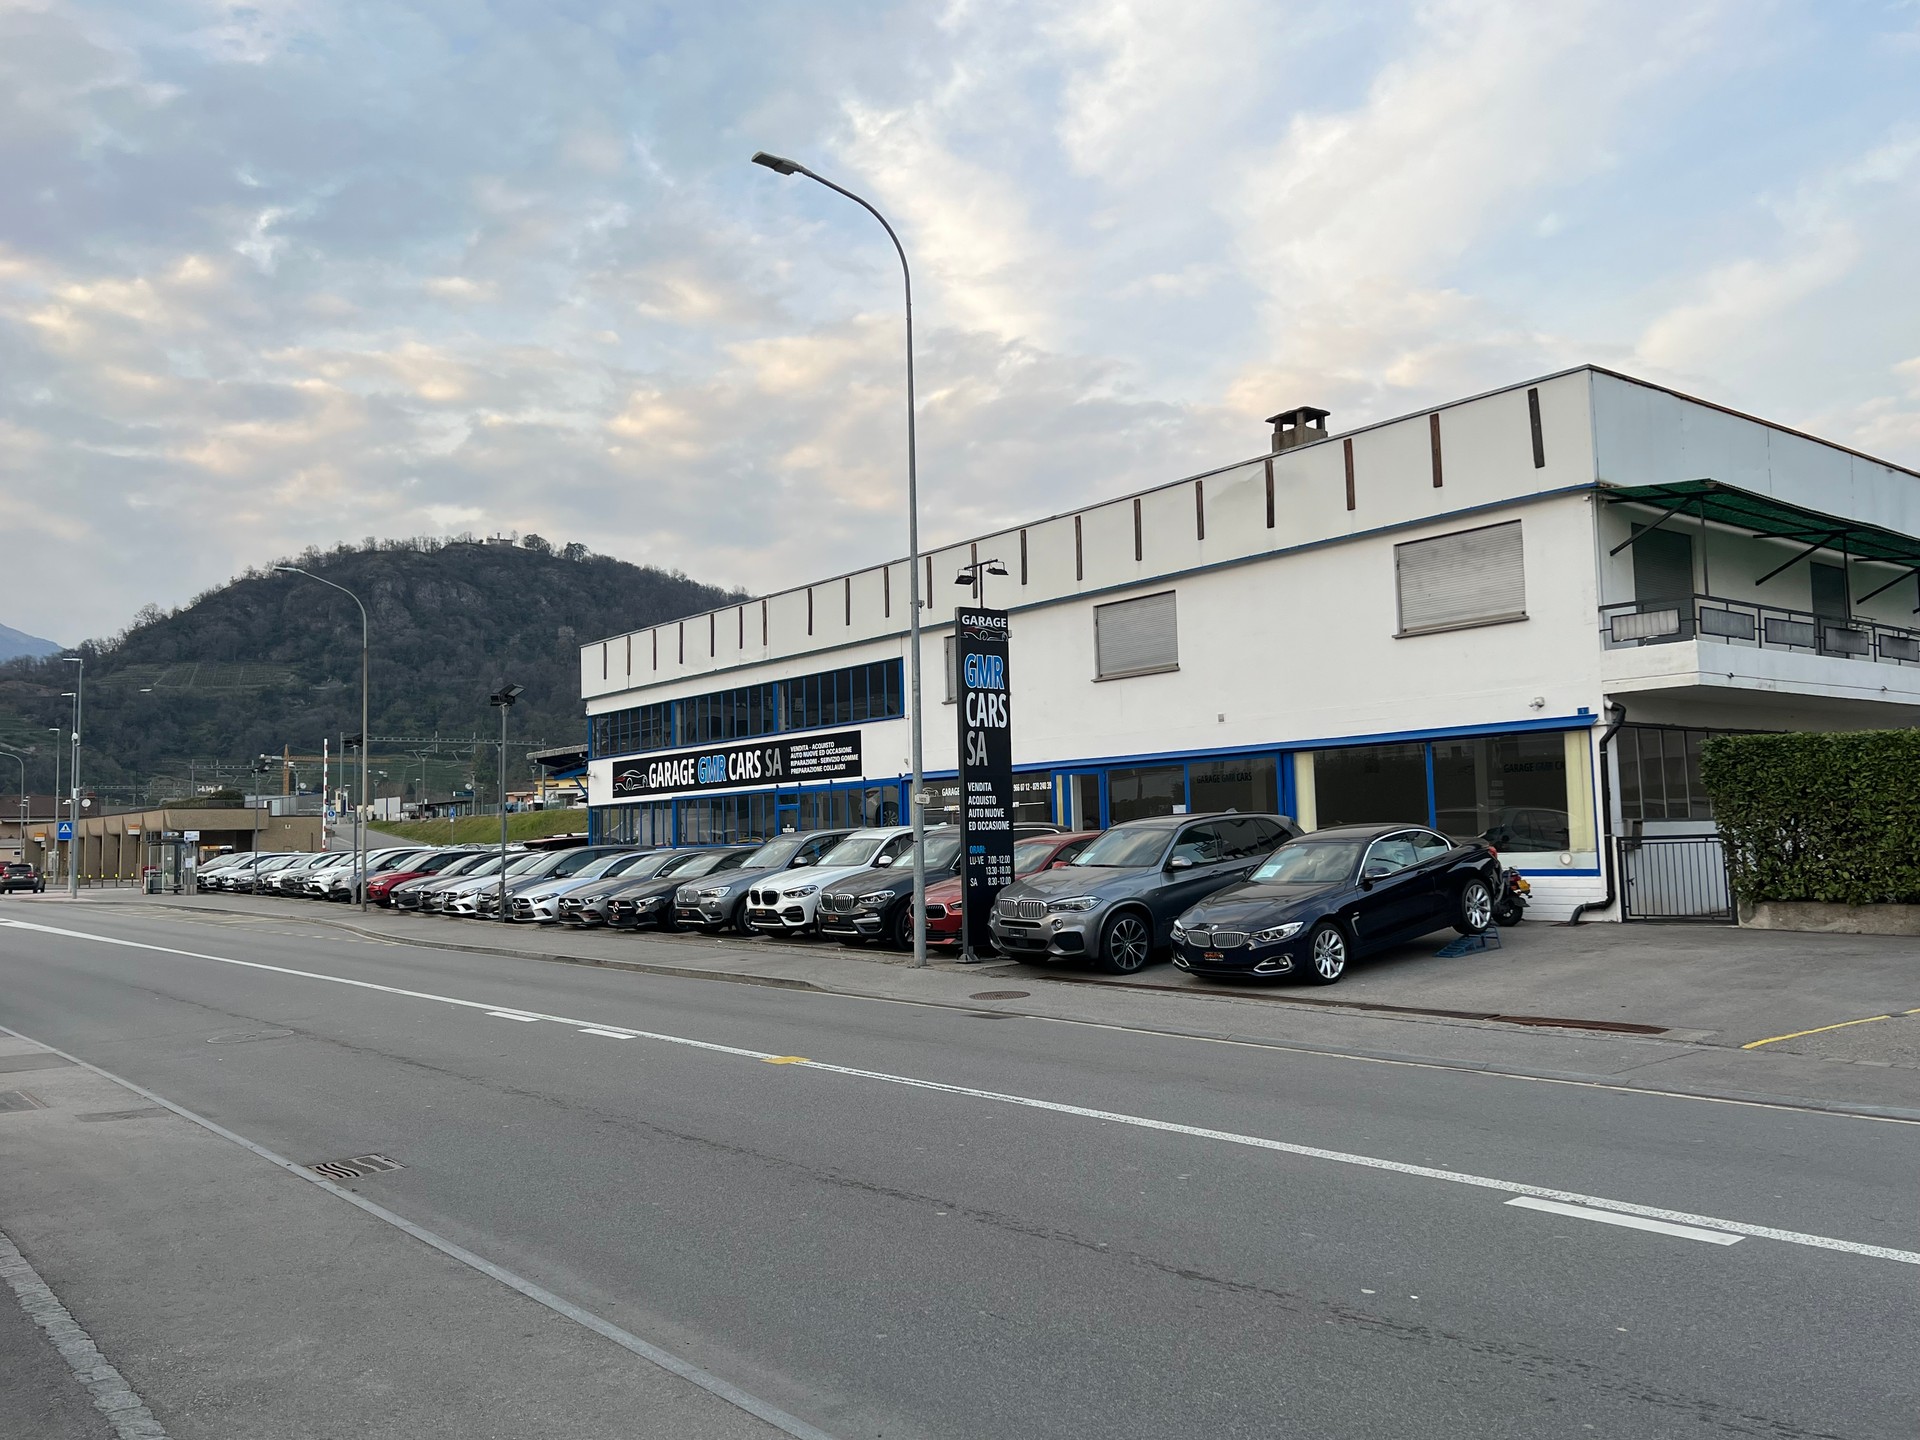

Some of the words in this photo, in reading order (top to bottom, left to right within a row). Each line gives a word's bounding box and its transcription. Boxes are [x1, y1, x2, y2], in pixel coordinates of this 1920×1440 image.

[961, 614, 1007, 628] GARAGE
[964, 653, 1005, 690] GMR
[966, 691, 1008, 729] CARS
[966, 730, 988, 767] SA
[648, 758, 695, 789] GARAGE
[697, 754, 727, 785] GMR
[728, 749, 762, 781] CARS
[764, 747, 783, 777] SA
[790, 766, 823, 774] PREPARAZIONE
[1504, 762, 1534, 773] GARAGE
[1197, 774, 1220, 784] GARAGE
[1236, 772, 1252, 782] CARS
[942, 787, 960, 796] GARAGE
[967, 782, 992, 792] VENDITA
[968, 795, 996, 805] ACQUISTO
[968, 808, 984, 819] AUTO
[984, 808, 1005, 818] NUOVE
[968, 821, 977, 831] ED
[978, 820, 1010, 830] OCCASIONE
[970, 856, 984, 865] LU-VE
[970, 878, 978, 886] SA
